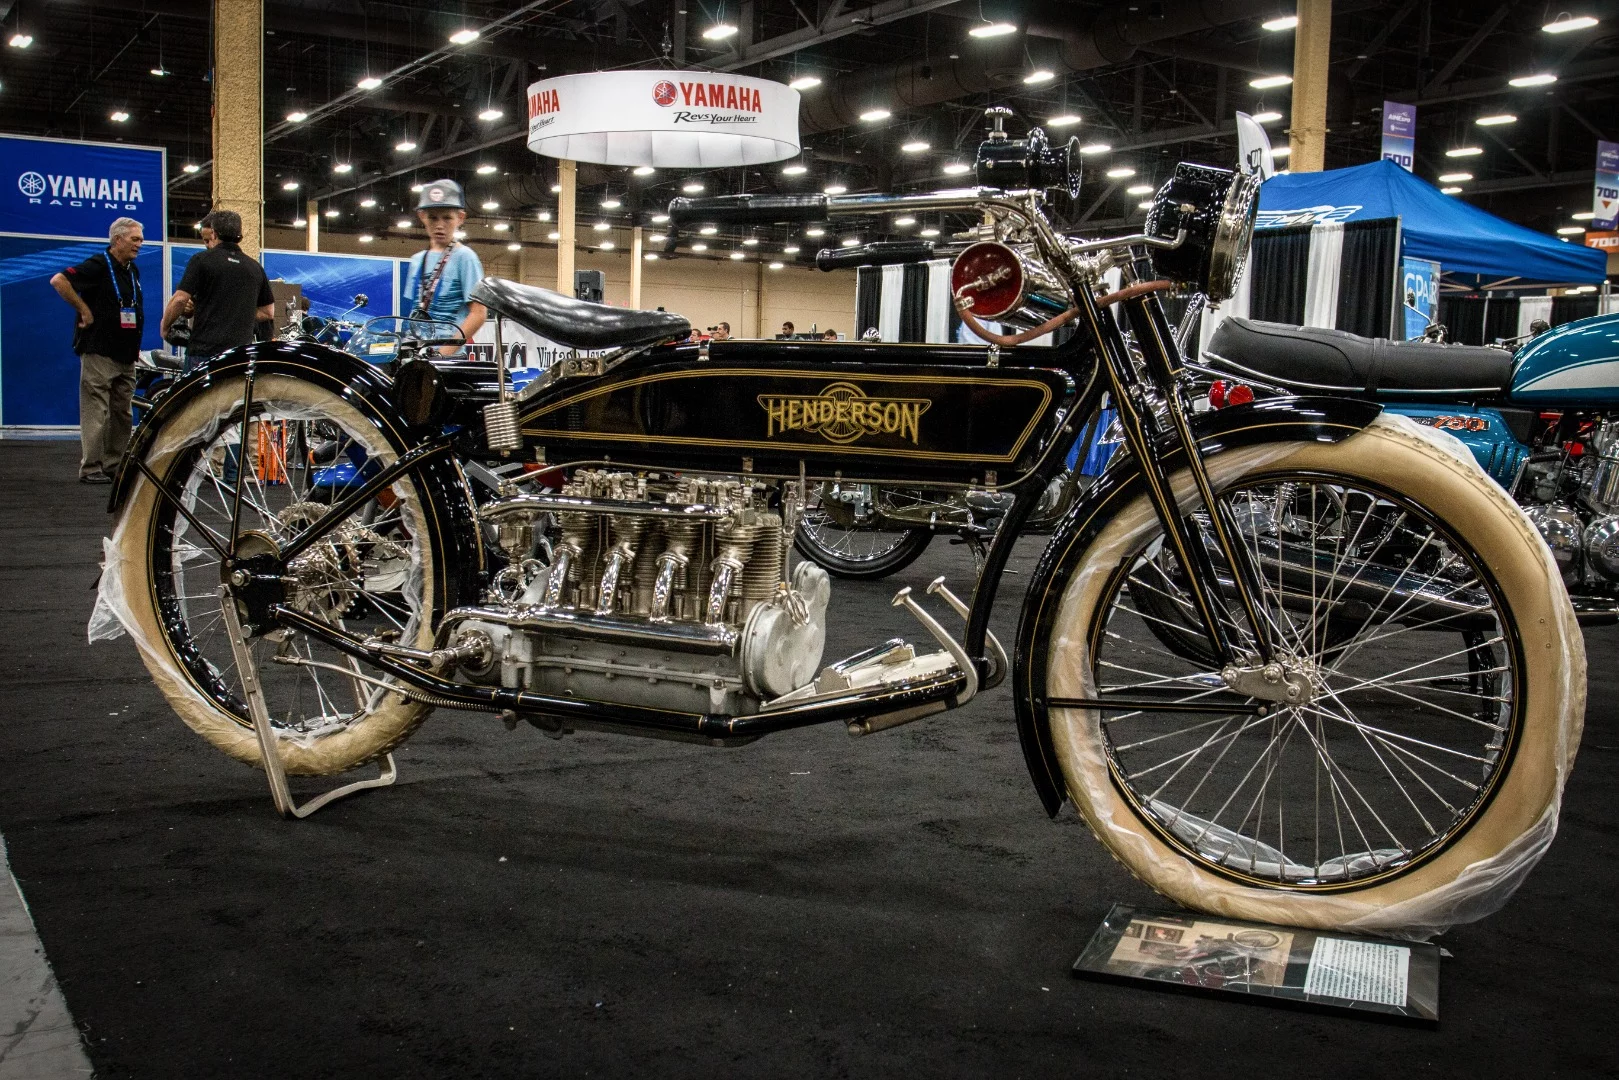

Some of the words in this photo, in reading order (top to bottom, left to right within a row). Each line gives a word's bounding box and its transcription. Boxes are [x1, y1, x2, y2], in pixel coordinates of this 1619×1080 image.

[529, 89, 560, 119] MAHA
[679, 82, 762, 113] YAMAHA
[673, 111, 709, 123] Revs
[47, 174, 144, 203] YAMAHA
[1597, 186, 1618, 200] 700
[29, 198, 137, 211] RACING
[1589, 237, 1619, 248] 700
[767, 398, 920, 446] HENDERSON
[1432, 415, 1484, 432] 750
